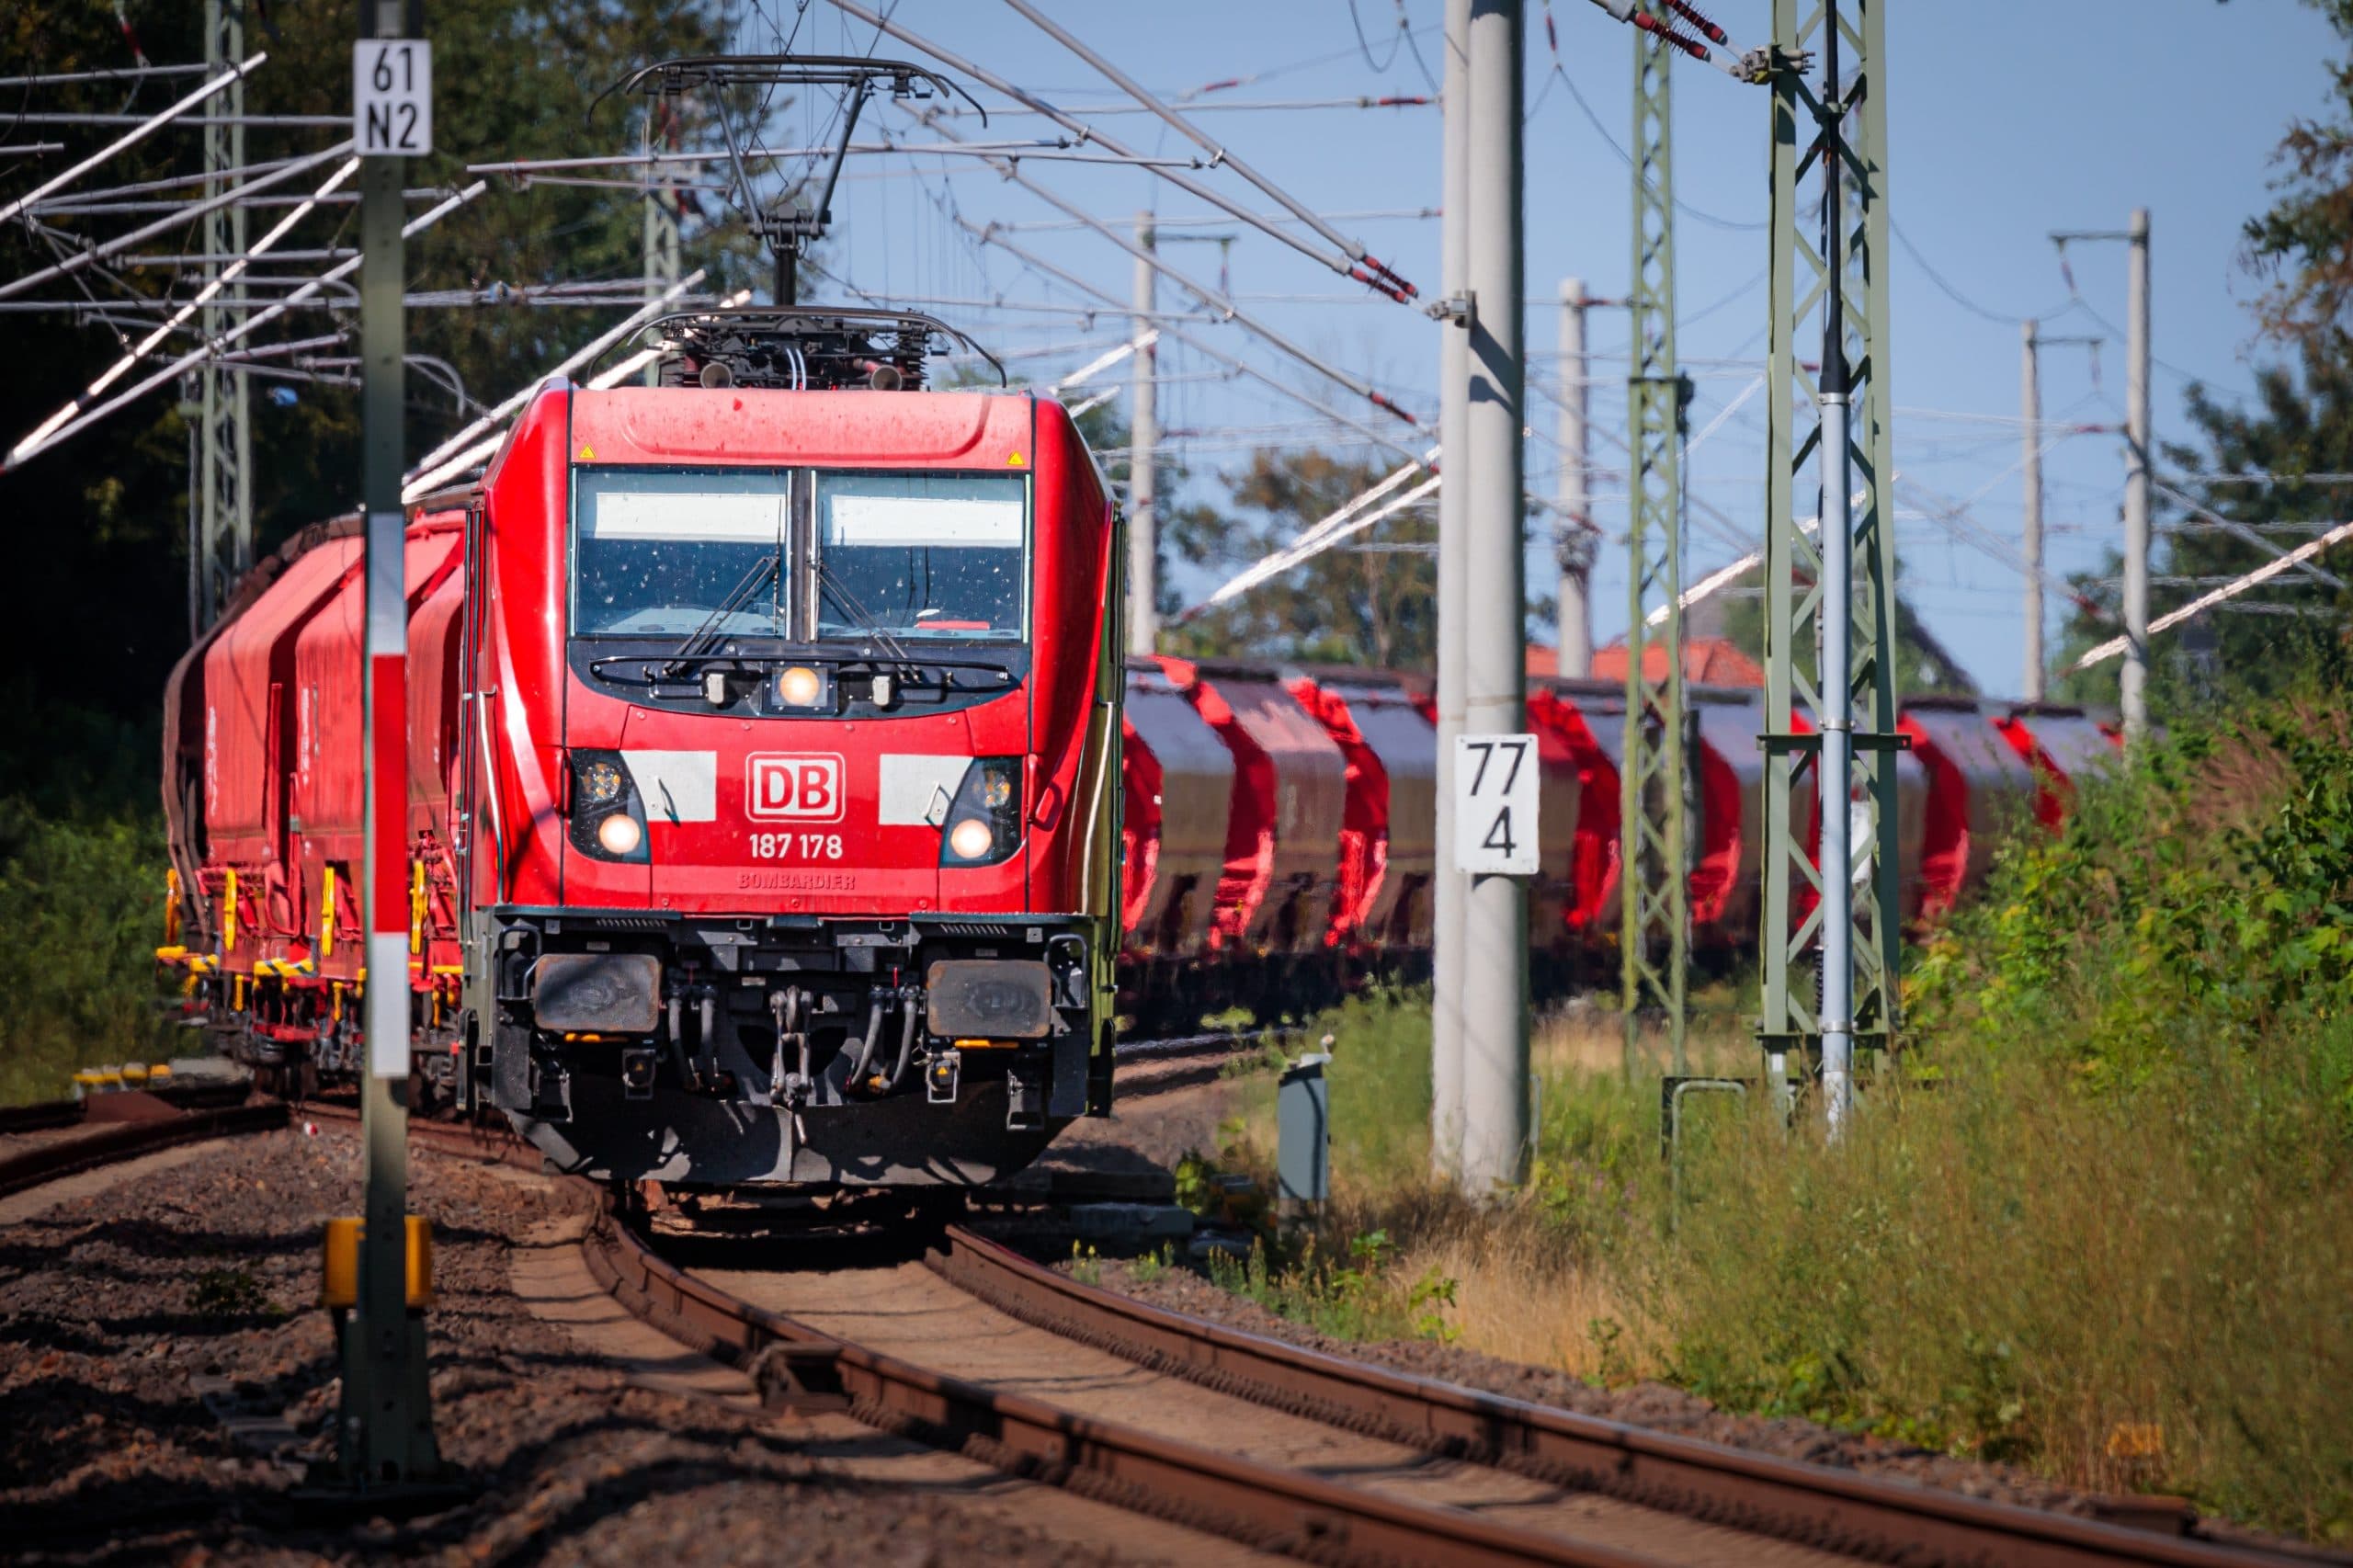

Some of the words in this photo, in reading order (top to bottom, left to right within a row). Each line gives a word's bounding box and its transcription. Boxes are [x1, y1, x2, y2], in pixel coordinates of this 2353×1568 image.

[373, 47, 412, 92] 61
[369, 103, 417, 148] N2
[760, 765, 831, 810] DB
[1467, 743, 1528, 796] 77
[749, 834, 792, 858] 187
[799, 835, 843, 859] 178
[1482, 805, 1517, 858] 4
[738, 874, 856, 891] BOMBARDIER
